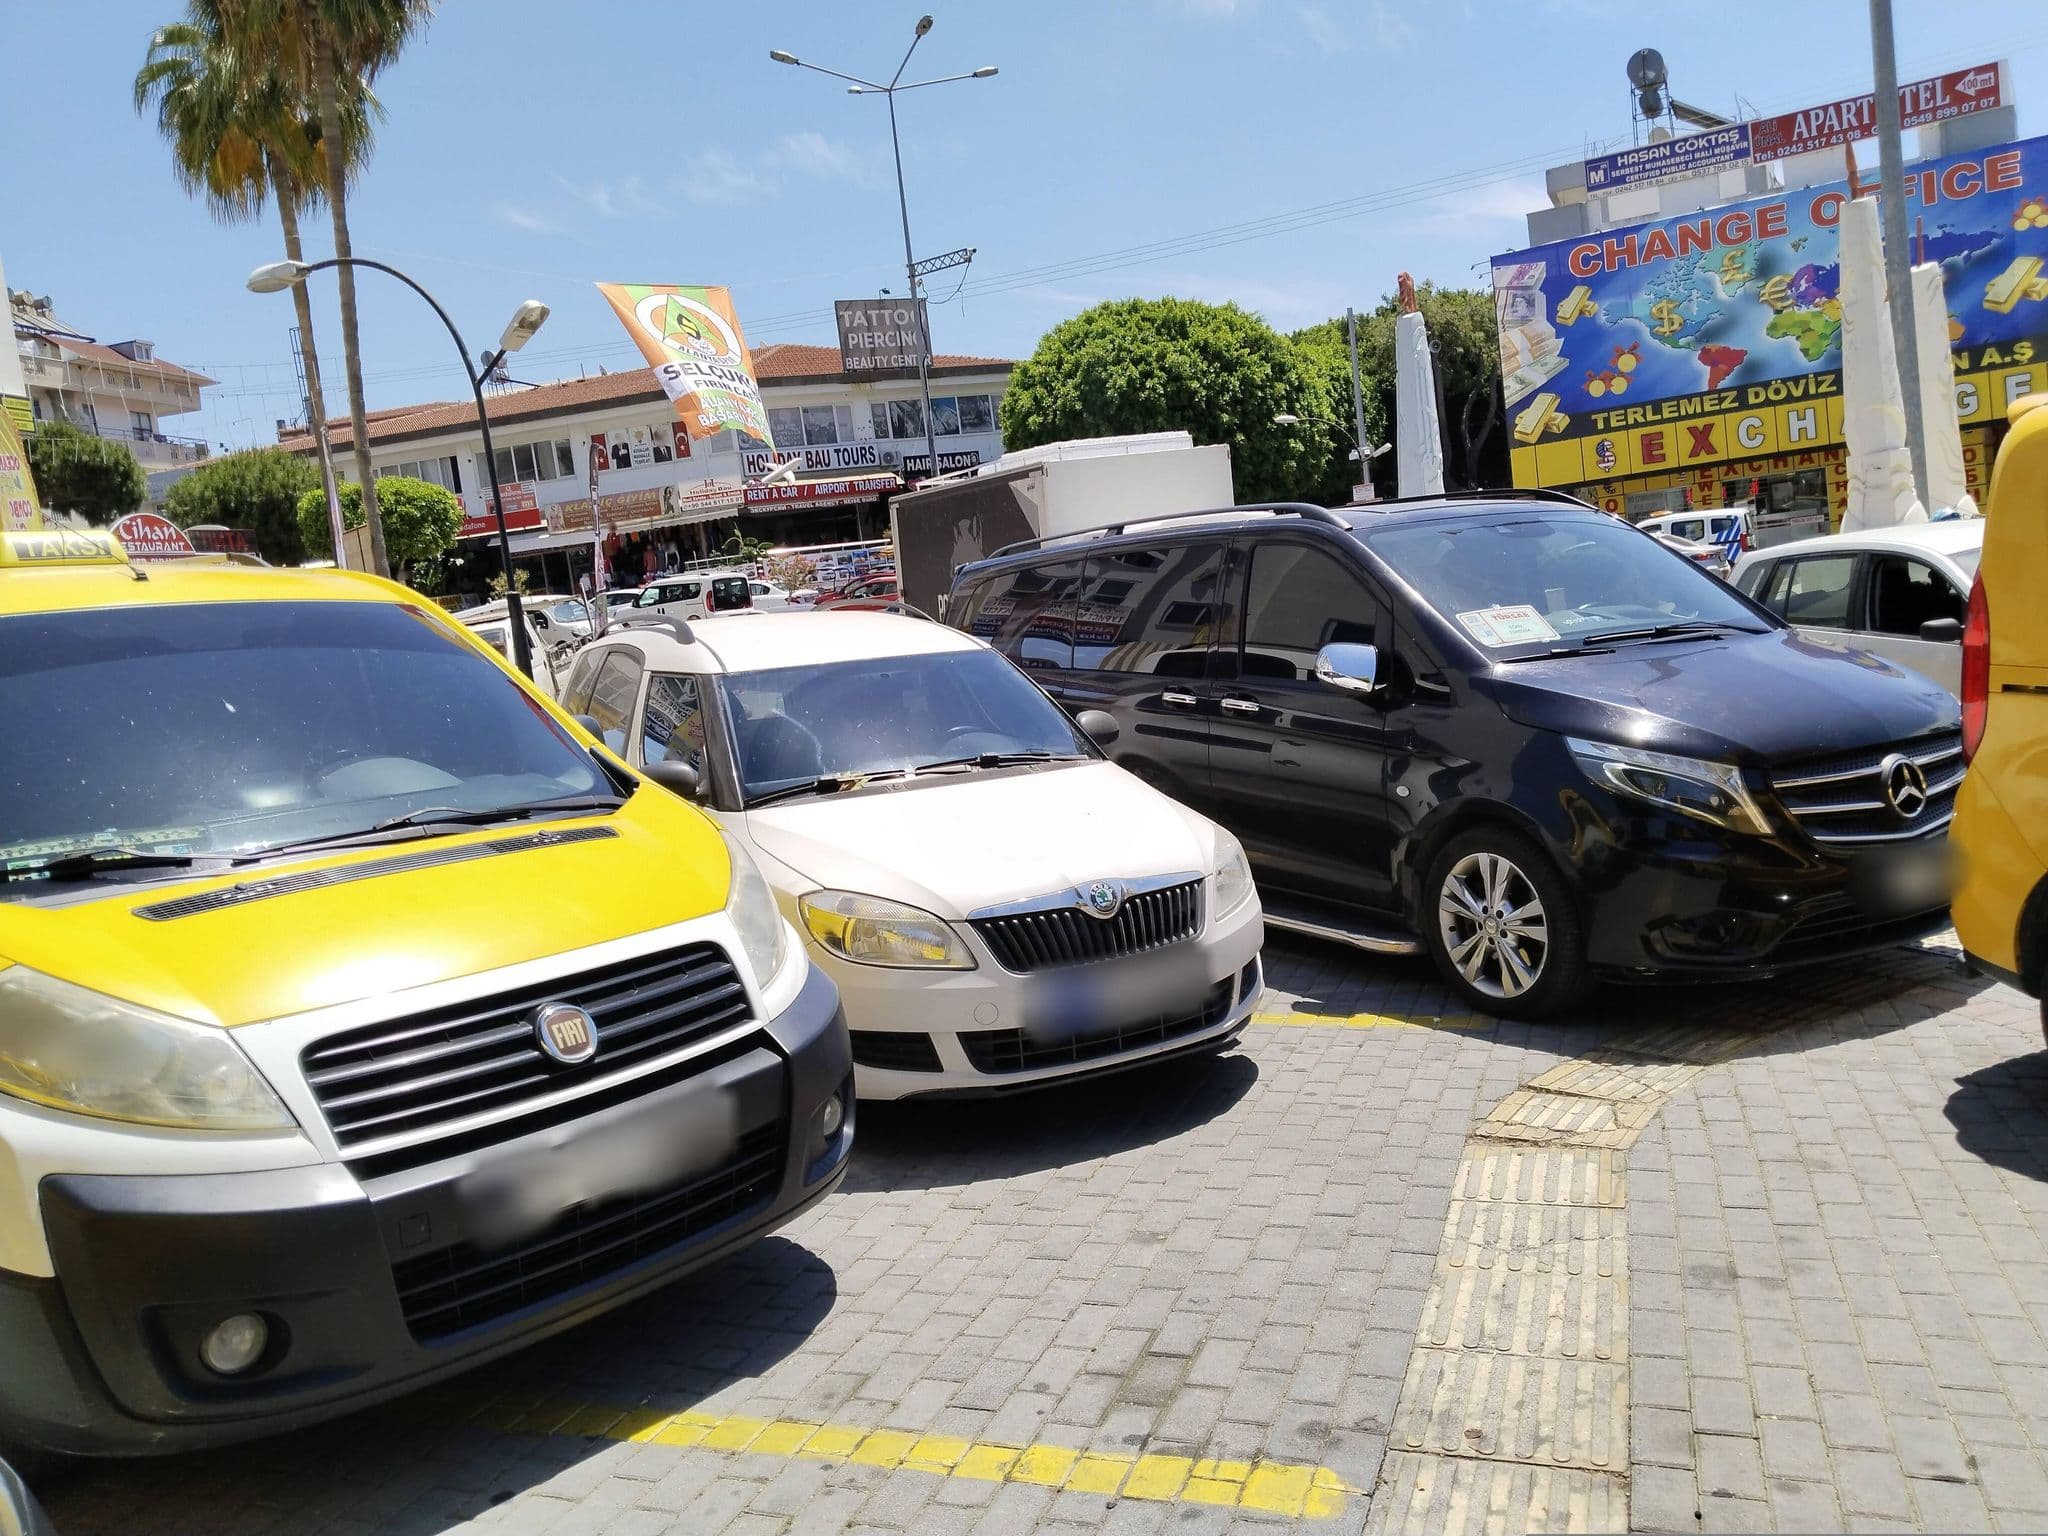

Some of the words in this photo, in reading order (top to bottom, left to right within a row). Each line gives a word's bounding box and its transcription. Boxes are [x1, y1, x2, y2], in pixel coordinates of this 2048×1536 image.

[1754, 151, 1776, 162] Tel:
[1777, 144, 1804, 157] 0242
[1806, 139, 1826, 151] 517
[1830, 134, 1844, 145] 43
[1846, 130, 1861, 142] 08
[1903, 112, 1933, 127] 0549
[1935, 106, 1959, 119] 899
[1961, 102, 1977, 114] 07
[1979, 97, 1995, 109] 07
[1617, 144, 1671, 168] HASAN
[1674, 129, 1740, 154] GÖKTAŞ
[1610, 165, 1644, 178] SERBEST
[1625, 169, 1661, 183] CERTIFIED
[1661, 162, 1686, 176] PUBLIC
[1687, 153, 1735, 171] ACCOUNTANT
[1568, 203, 1790, 278] CHANGE
[845, 356, 889, 370] BEAUTY
[890, 352, 932, 367] CENTR
[1592, 393, 1740, 430] TERLEMEZ
[1748, 374, 1837, 406] DÖVİZ
[805, 448, 833, 469] BAU
[834, 445, 876, 467] TOURS
[936, 454, 972, 469] SALON
[747, 489, 769, 501] RENT
[772, 487, 779, 498] A
[780, 486, 798, 497] CAR
[815, 482, 851, 495] AIRPORT
[853, 476, 896, 492] TRANSFER
[119, 518, 176, 540] Cihan
[122, 541, 185, 552] ESTAURANT
[551, 1018, 587, 1049] FIAT
